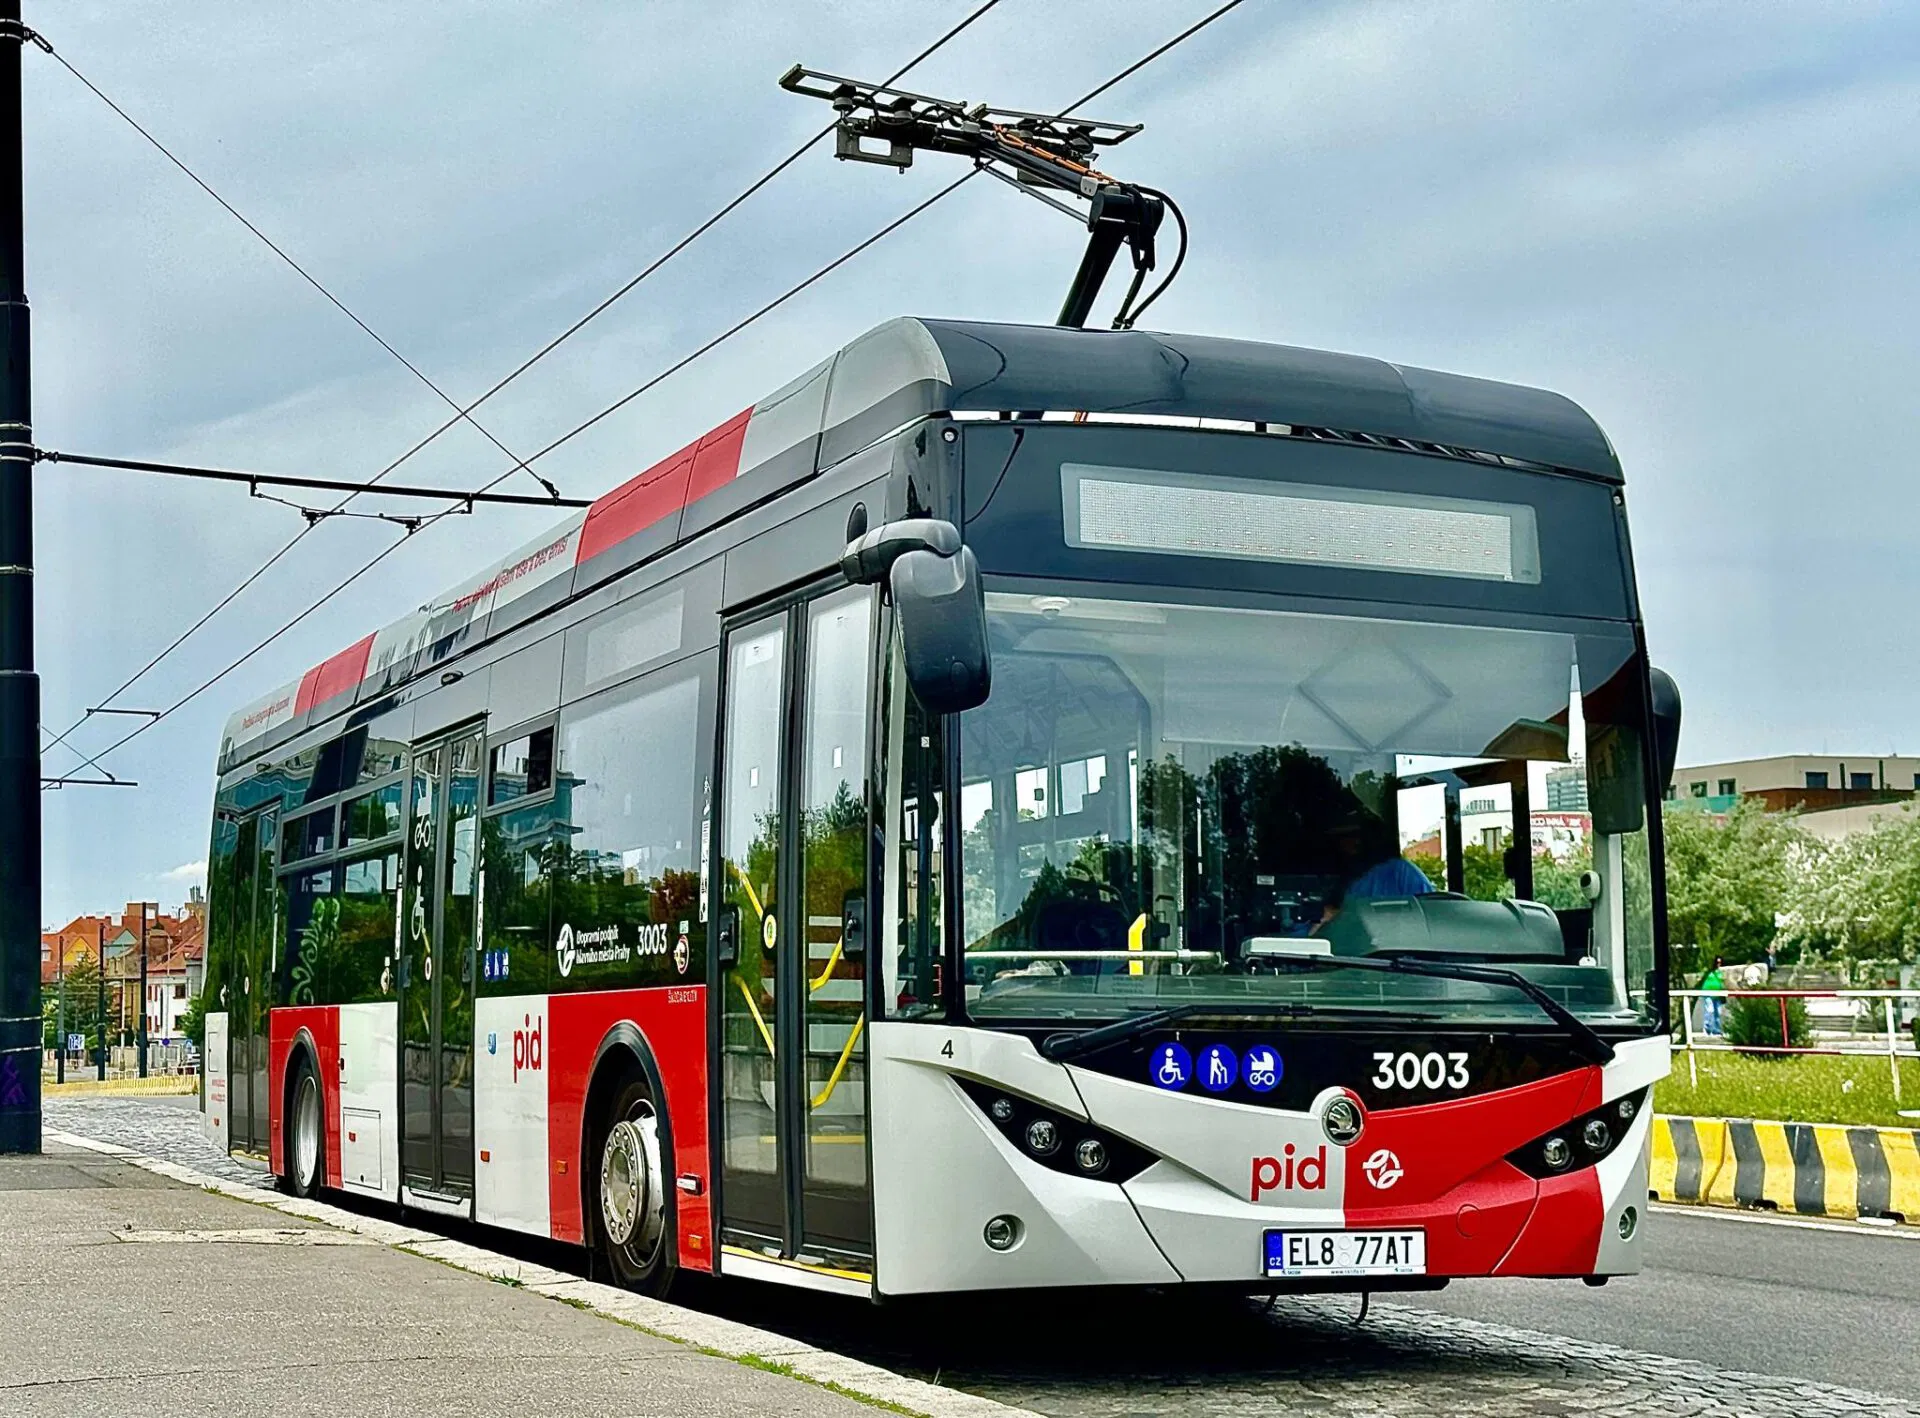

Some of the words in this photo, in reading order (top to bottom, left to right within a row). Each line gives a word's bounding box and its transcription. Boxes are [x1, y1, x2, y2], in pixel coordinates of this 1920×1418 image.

[637, 923, 668, 955] 3003
[513, 1013, 541, 1083] pid
[941, 1039, 954, 1059] 4
[1372, 1051, 1470, 1090] 3003
[1251, 1142, 1326, 1202] pid
[1269, 1256, 1282, 1267] CZ
[1288, 1236, 1335, 1266] EL8
[1354, 1235, 1413, 1265] 77AT
